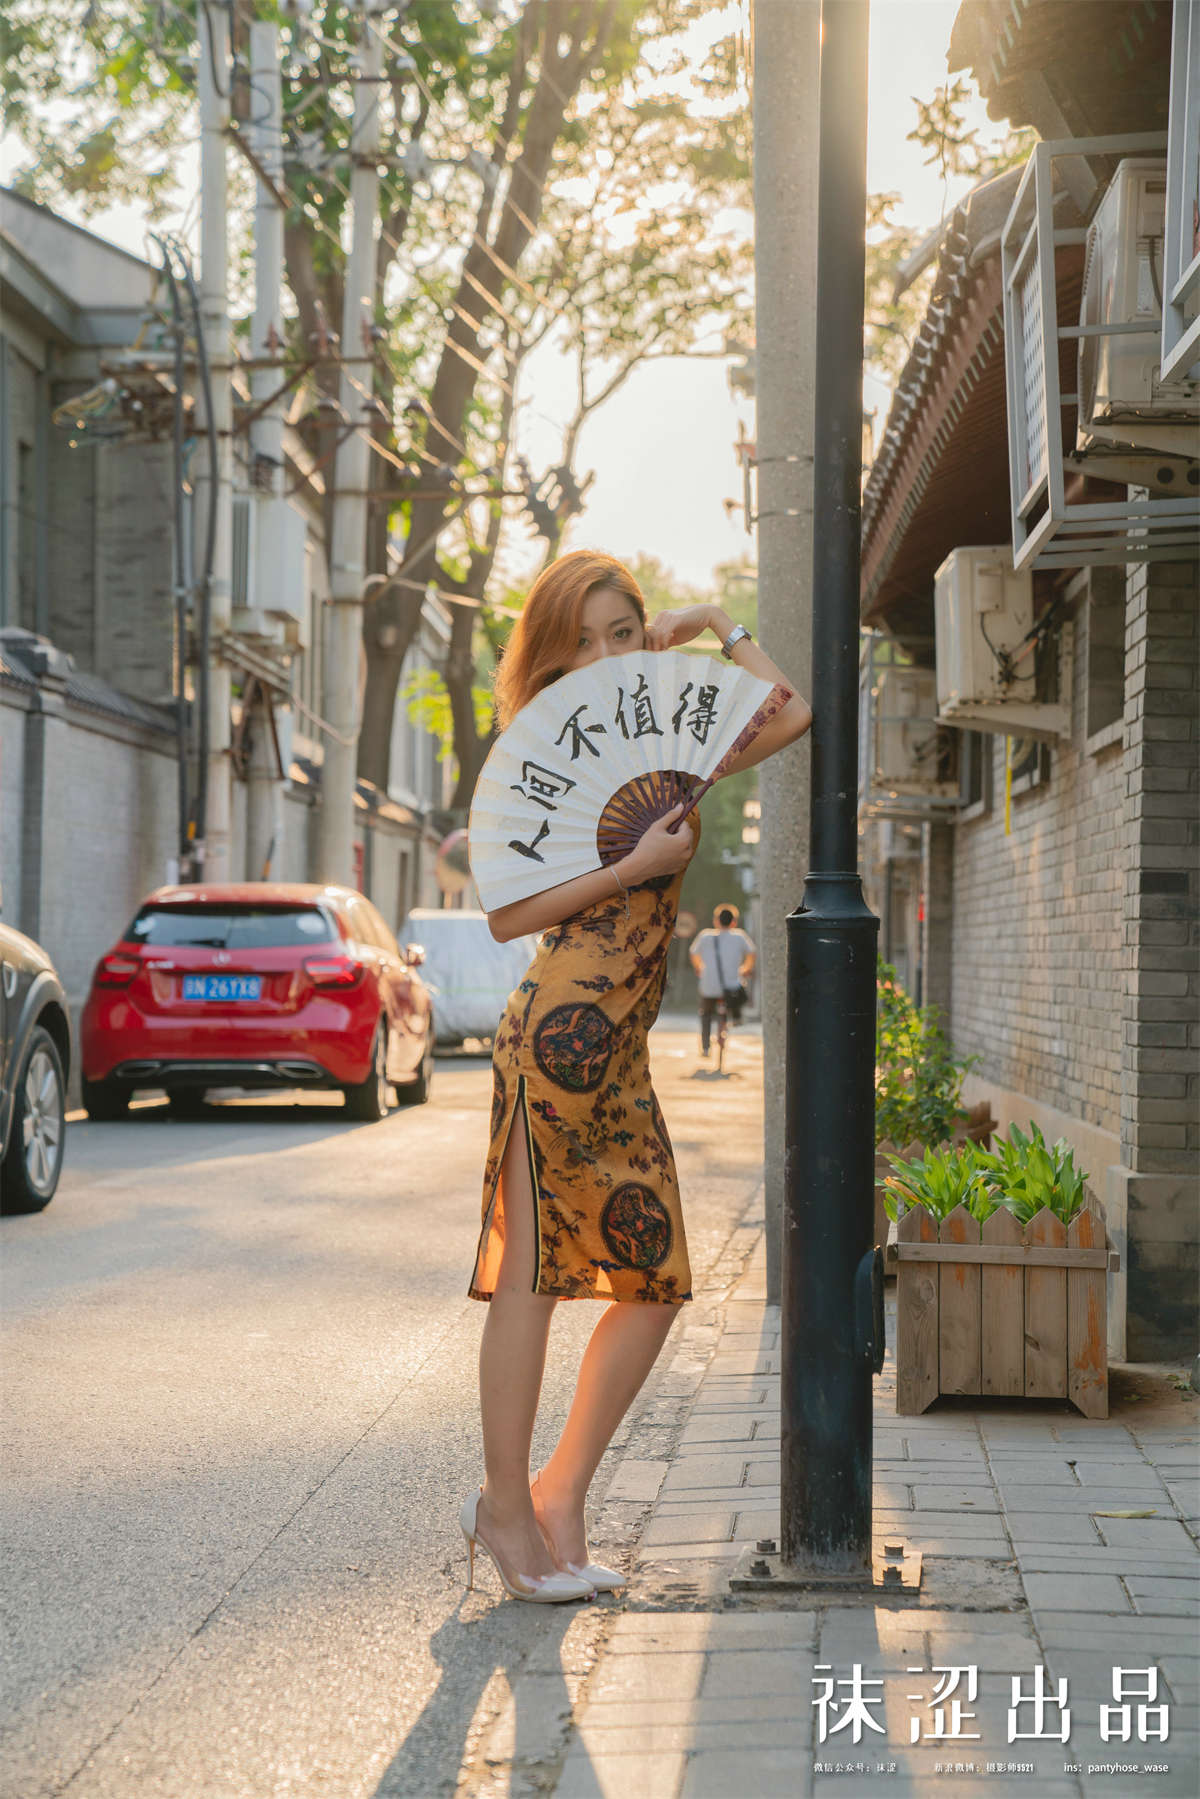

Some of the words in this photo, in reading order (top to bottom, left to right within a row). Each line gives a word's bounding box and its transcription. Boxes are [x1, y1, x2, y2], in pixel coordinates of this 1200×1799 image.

[507, 673, 720, 865] 人间不值得
[185, 977, 205, 995] N
